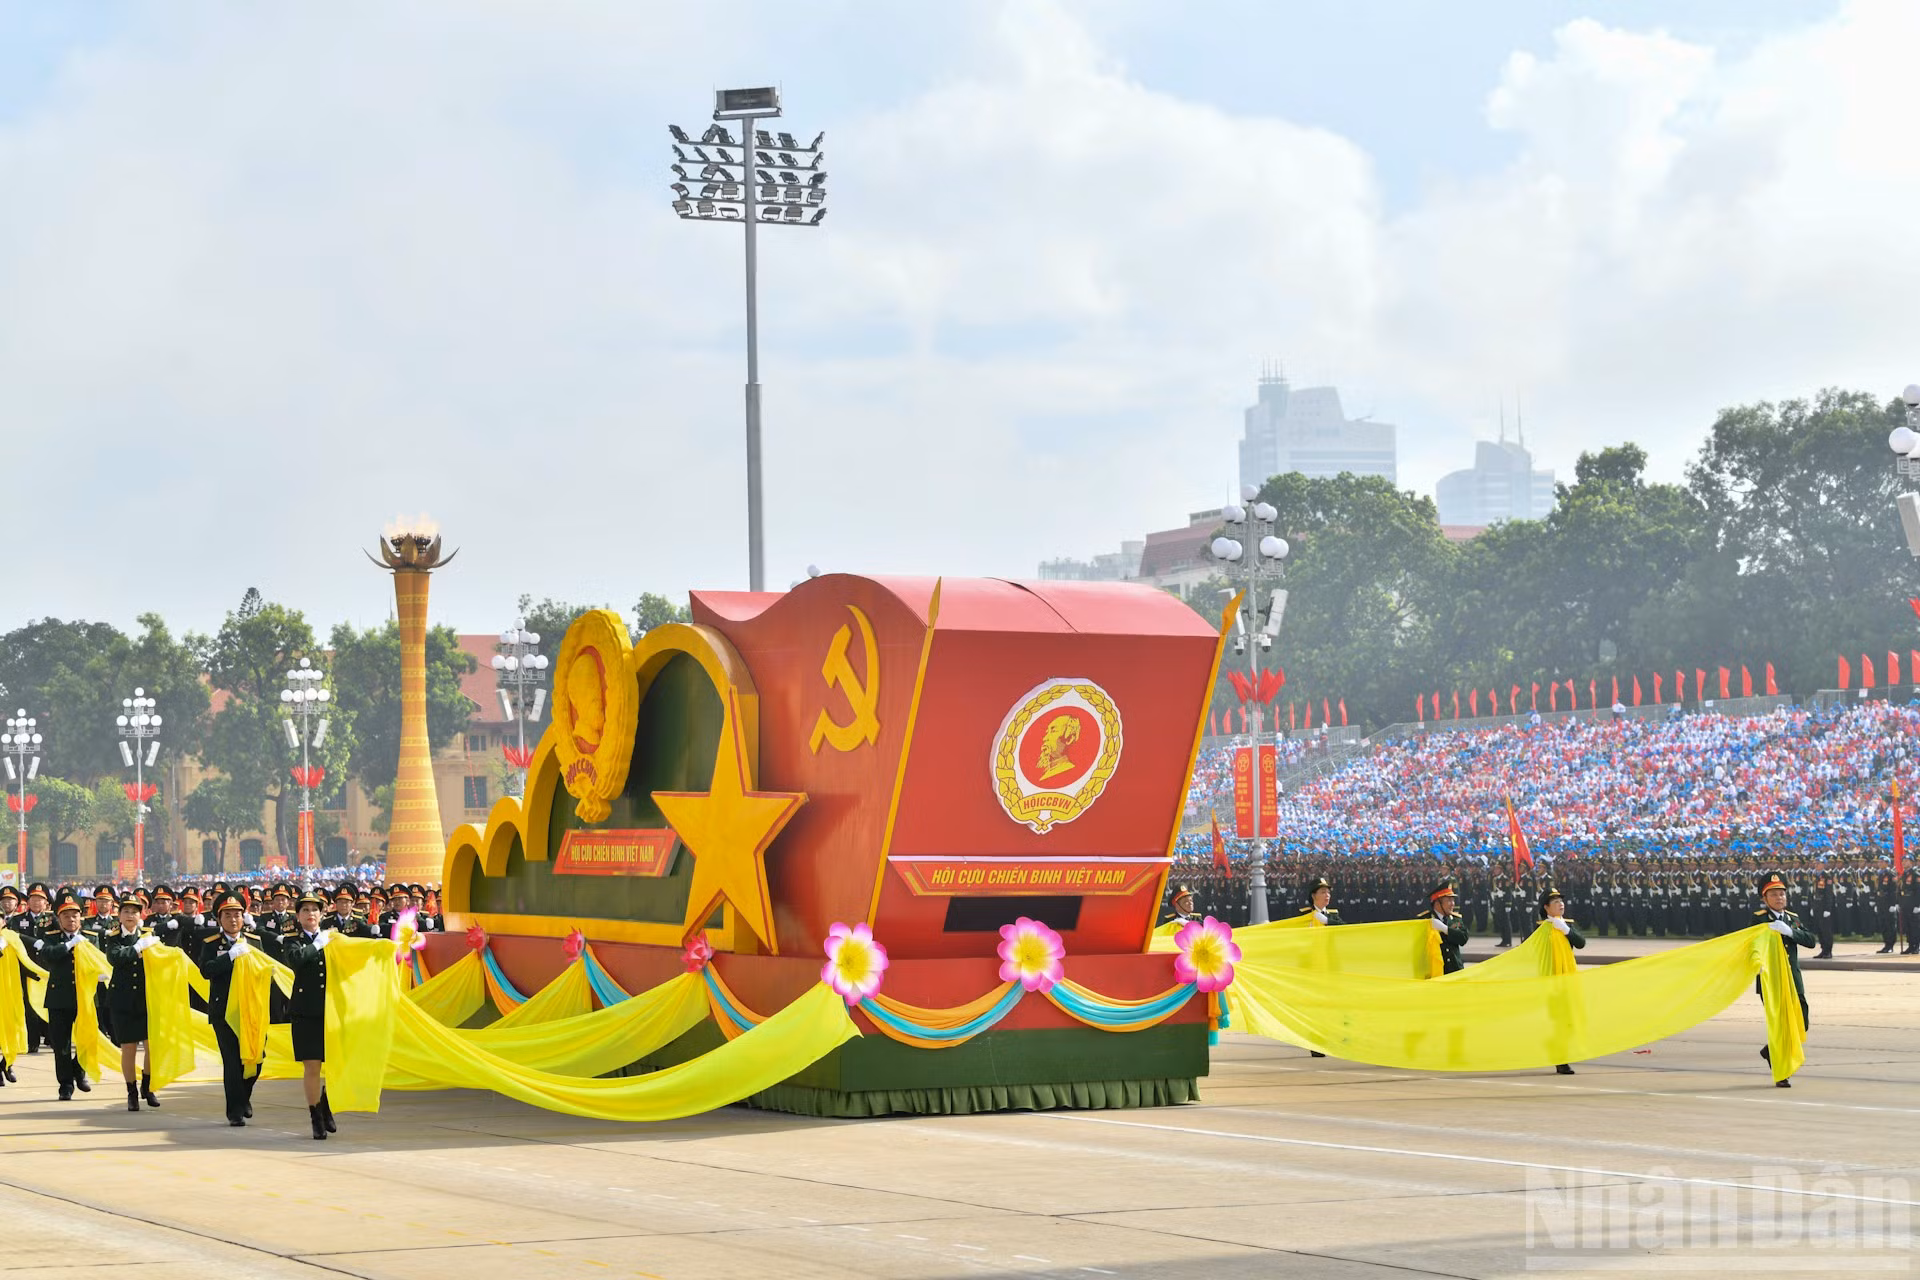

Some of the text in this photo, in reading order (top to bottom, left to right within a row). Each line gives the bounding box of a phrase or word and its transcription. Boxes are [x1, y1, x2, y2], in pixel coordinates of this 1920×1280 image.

[1023, 796, 1072, 810] HỘICCBVN
[611, 845, 625, 862] BINH
[626, 841, 639, 866] VIỆT
[640, 845, 654, 862] NAM
[932, 865, 1126, 887] HỘI CỰU CHIẾN BINH VIỆT NAM
